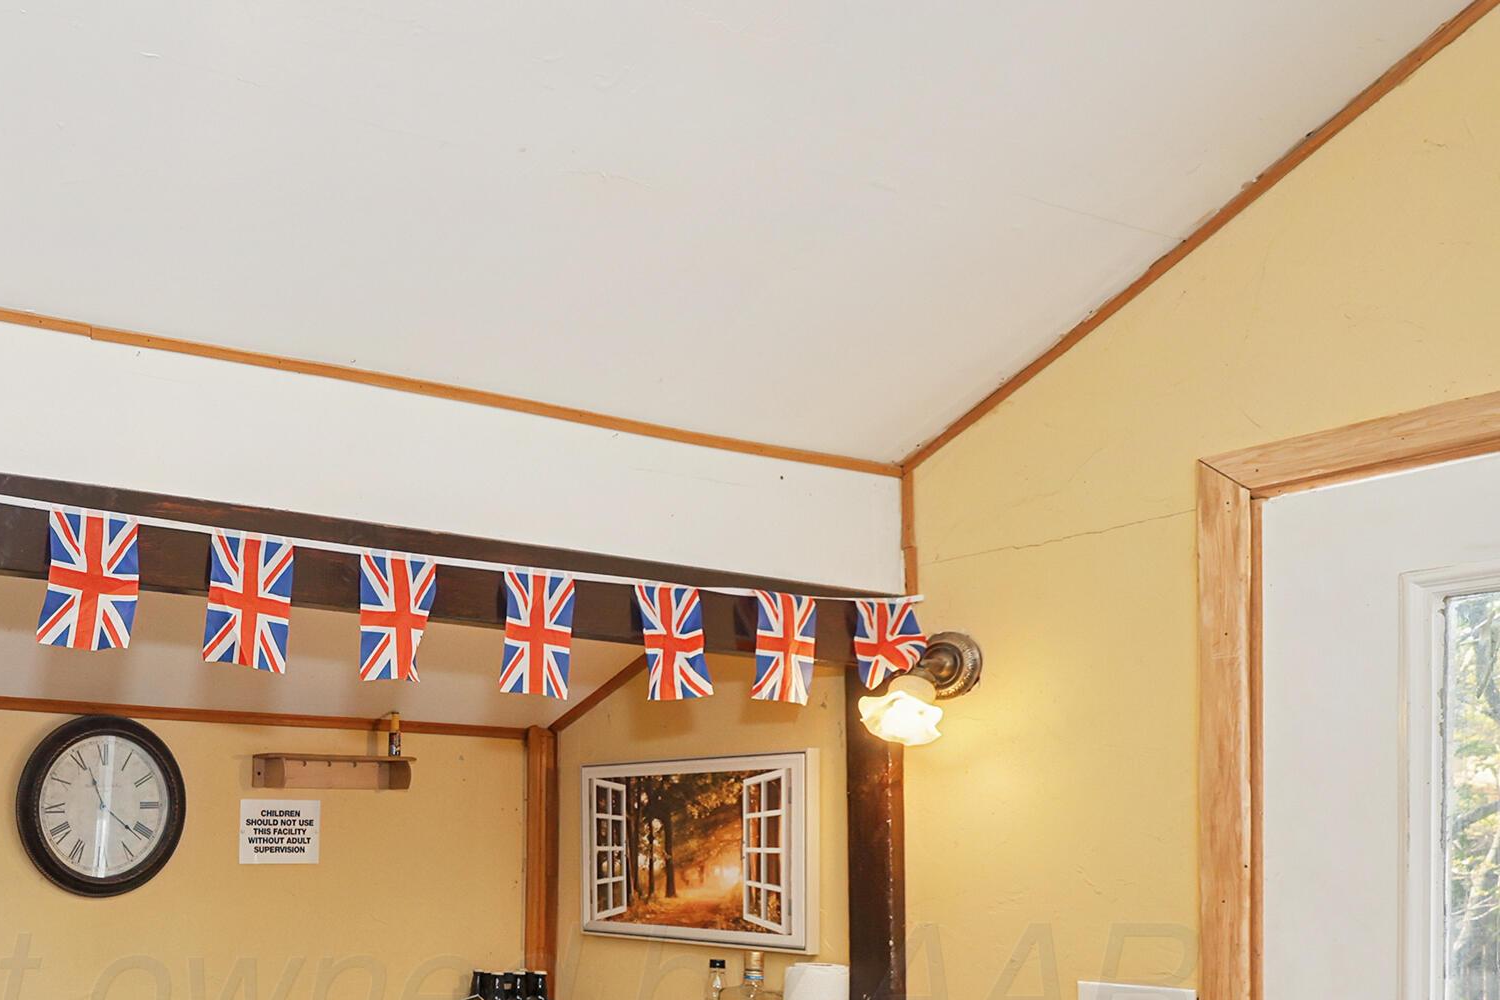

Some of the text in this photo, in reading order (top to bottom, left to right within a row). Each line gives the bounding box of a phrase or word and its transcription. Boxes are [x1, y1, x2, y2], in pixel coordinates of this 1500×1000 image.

[260, 809, 301, 817] CHILDREN
[245, 818, 279, 826] SHOULD
[298, 819, 314, 827] USE
[253, 845, 306, 853] SUPERVISION
